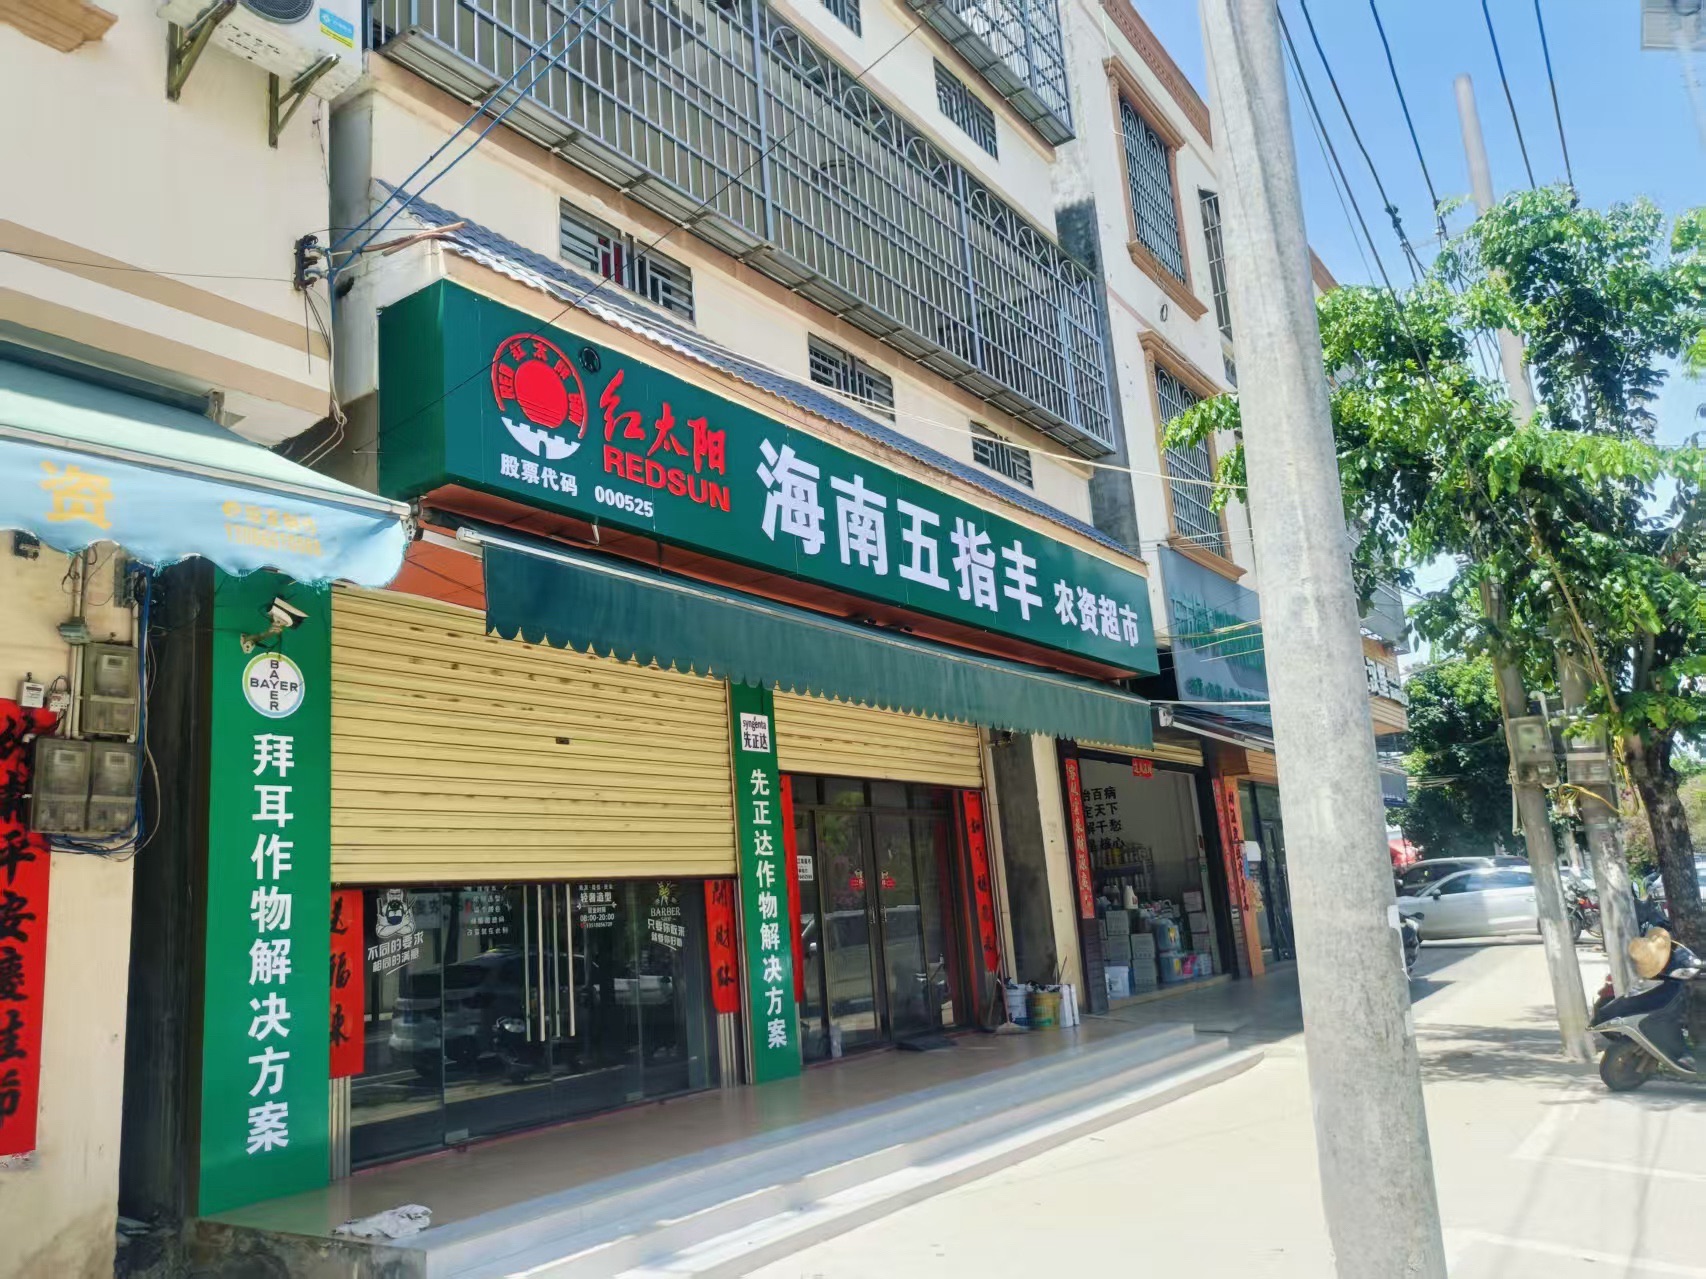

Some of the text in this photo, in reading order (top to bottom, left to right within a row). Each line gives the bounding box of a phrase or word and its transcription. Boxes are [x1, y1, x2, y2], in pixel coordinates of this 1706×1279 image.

[600, 368, 727, 476] 红太阳
[39, 460, 114, 531] 资
[500, 452, 654, 518] 股票代码 000525
[603, 443, 732, 513] REDSUN
[756, 437, 1140, 648] 海南五指丰 农资超市
[249, 676, 299, 693] BAYER
[743, 719, 767, 731] syngenta
[743, 731, 768, 750] 先正达
[580, 913, 615, 922] 08:00-20:00
[650, 906, 681, 917] BARBER
[749, 768, 788, 1050] 先正达作物解决方案
[245, 732, 296, 1155] 拜耳作物解决方案
[368, 931, 424, 961] 不同的要求
